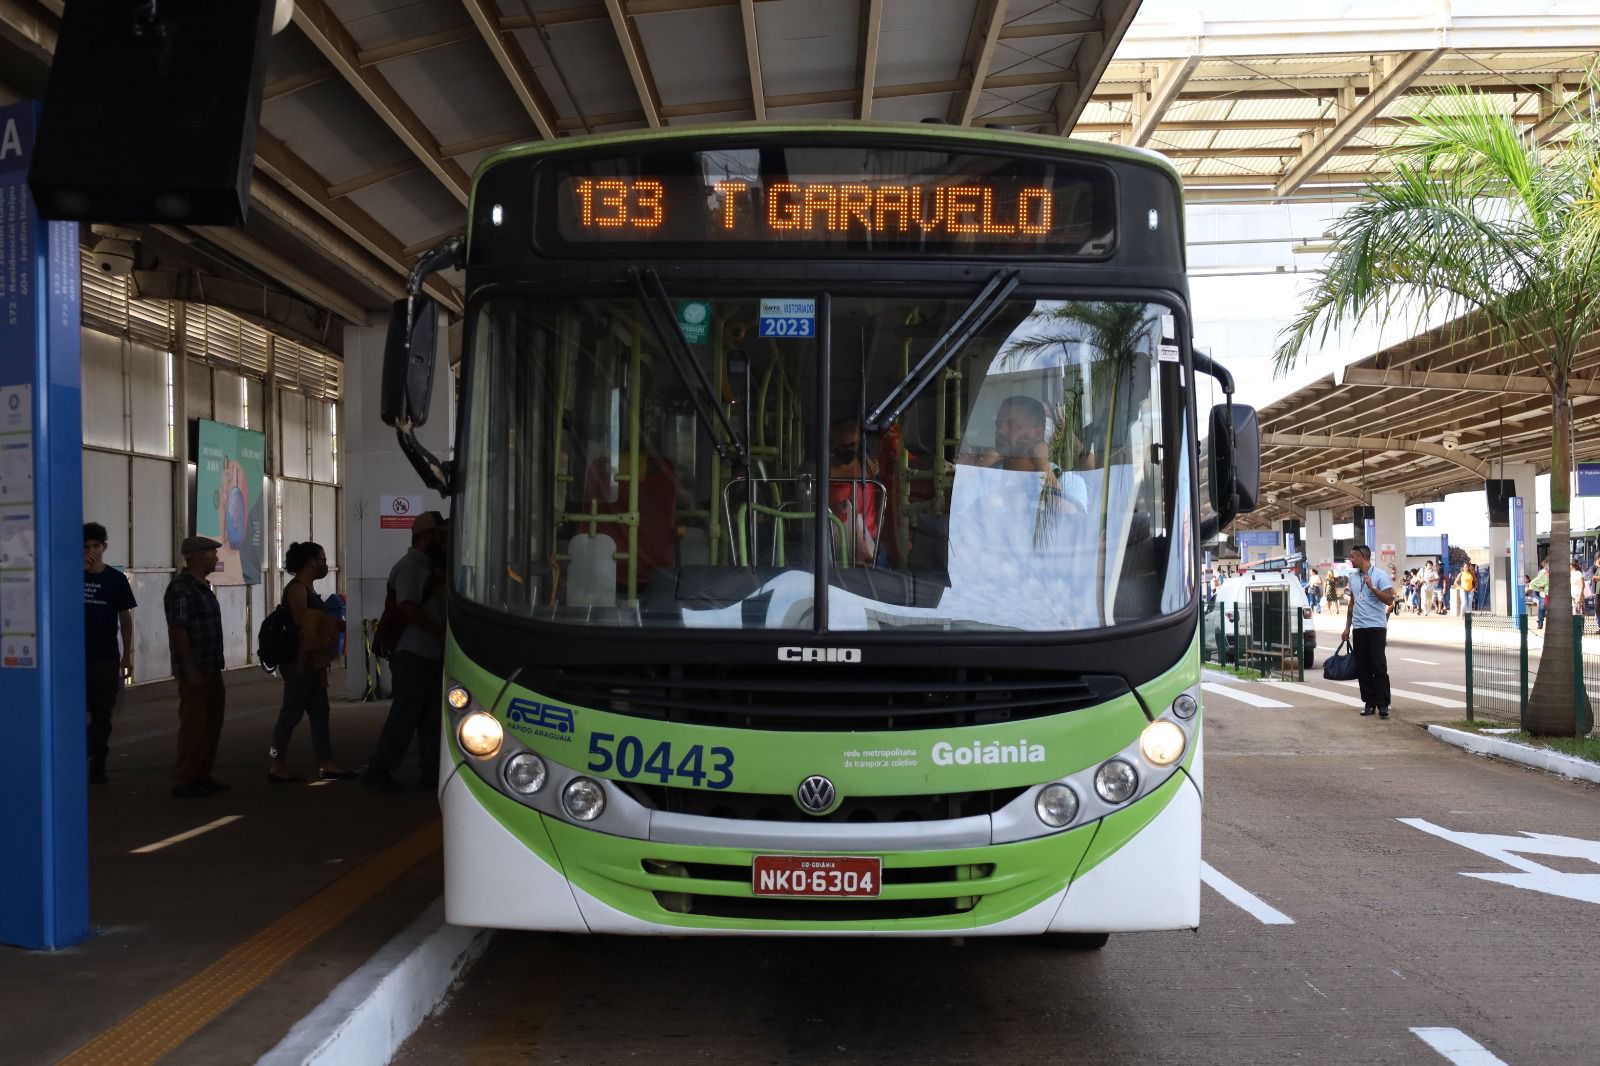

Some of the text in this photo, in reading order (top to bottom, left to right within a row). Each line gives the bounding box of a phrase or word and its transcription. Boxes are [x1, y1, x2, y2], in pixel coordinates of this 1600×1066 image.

[0, 118, 23, 160] A
[576, 181, 1052, 234] 133 T GARAVELO
[19, 271, 28, 295] 604
[783, 303, 814, 314] VISTORIADO
[764, 318, 810, 336] 2023
[1426, 511, 1433, 522] B
[777, 646, 862, 663] CAIO
[587, 731, 735, 790] 50443
[843, 748, 917, 759] rede metropolitana
[843, 760, 853, 768] de
[891, 759, 918, 767] coletivo
